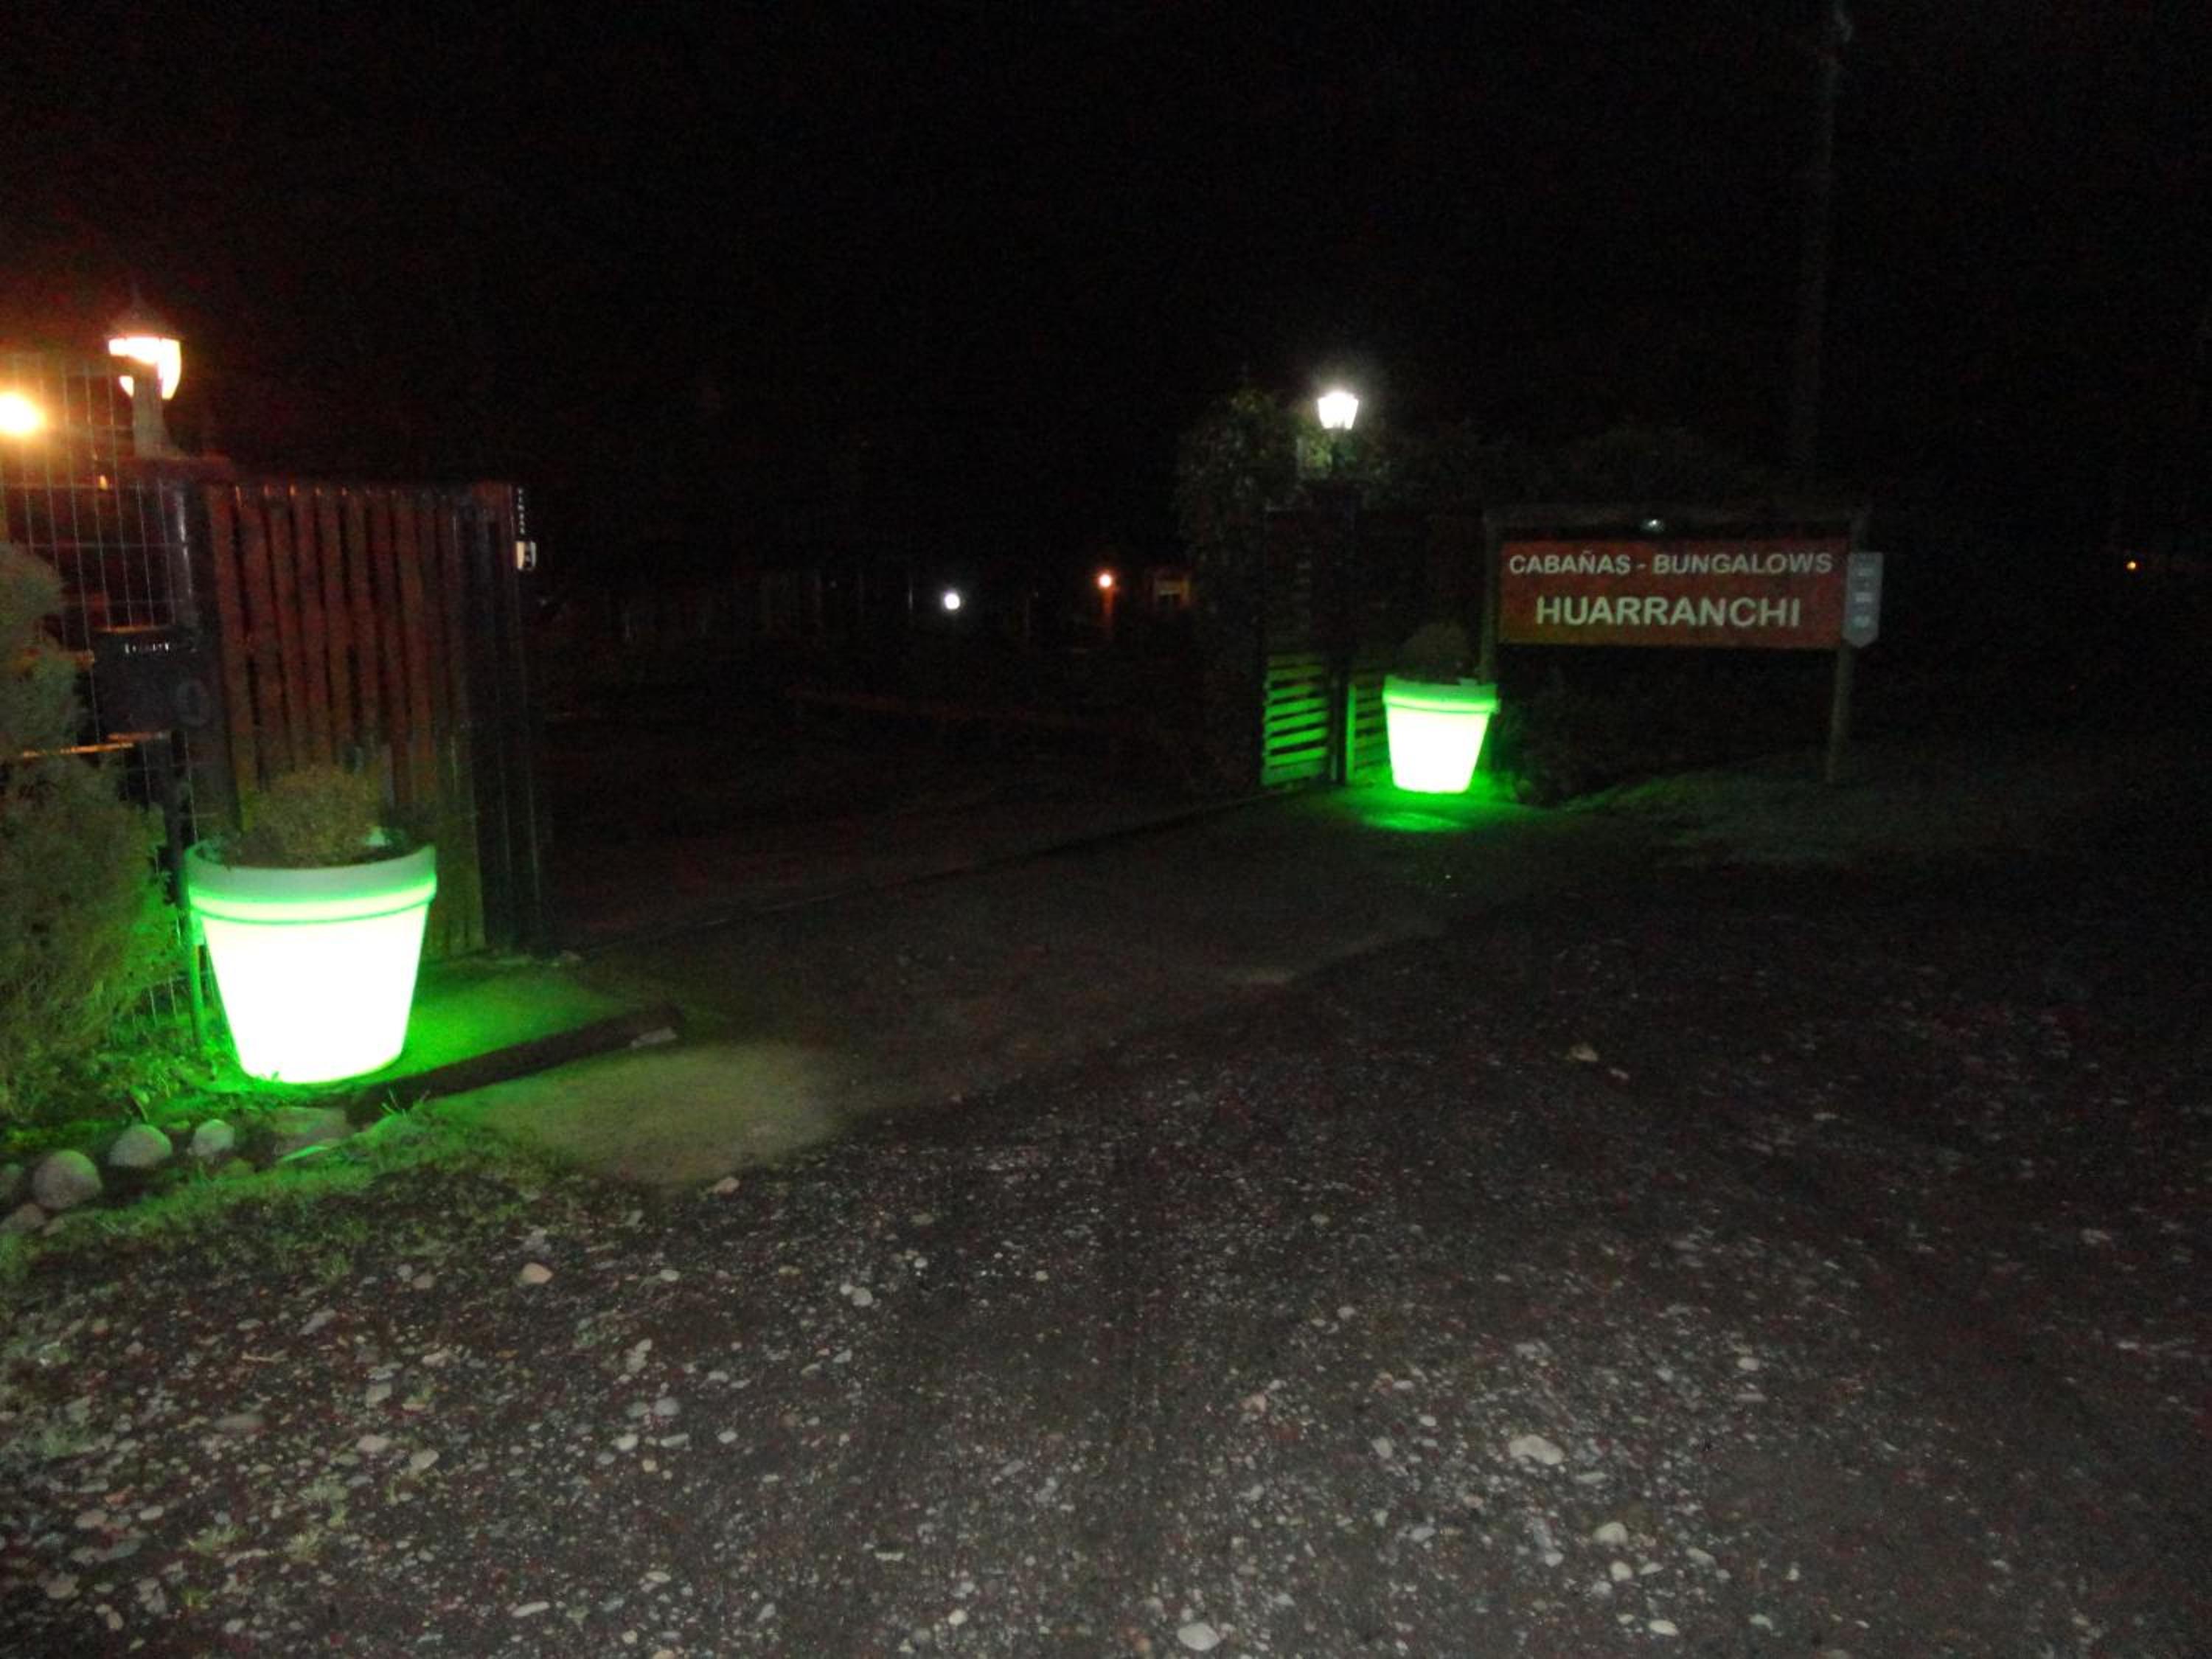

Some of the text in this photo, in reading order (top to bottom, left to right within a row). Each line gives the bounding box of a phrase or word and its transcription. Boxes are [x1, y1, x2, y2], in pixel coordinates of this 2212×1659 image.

[1509, 549, 1631, 575] CABAÑAS
[1652, 553, 1832, 574] BUNGALOWS
[1536, 596, 1801, 627] HUARRANCHI
